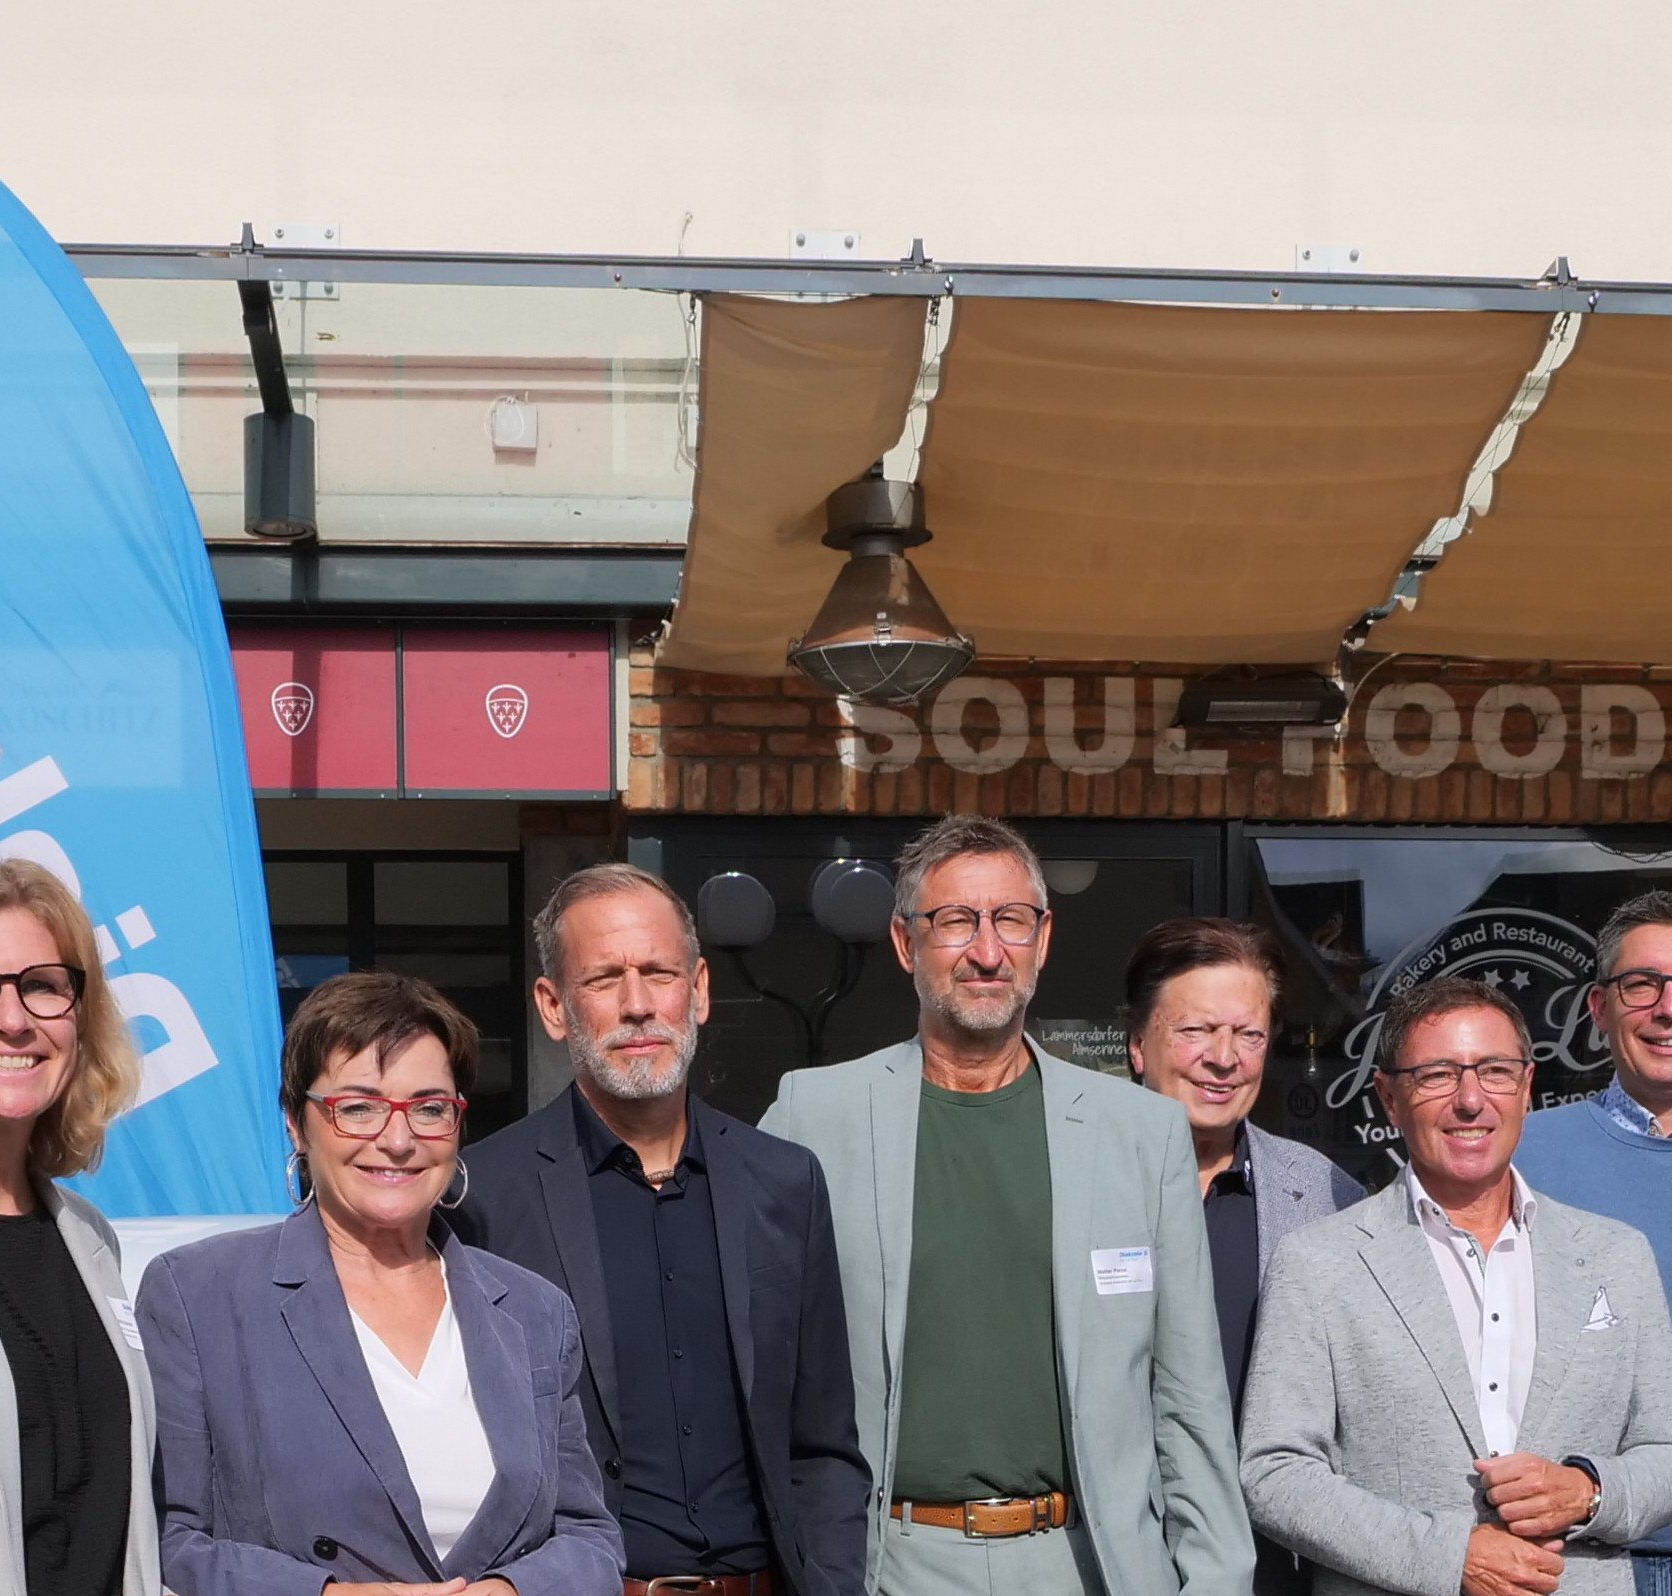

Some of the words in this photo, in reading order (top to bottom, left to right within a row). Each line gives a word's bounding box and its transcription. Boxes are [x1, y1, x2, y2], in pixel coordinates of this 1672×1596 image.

[835, 676, 1228, 776] SOUL
[1390, 944, 1448, 998] Bakery
[1449, 926, 1489, 952] and
[1493, 921, 1597, 974] Restaurant
[1042, 1026, 1126, 1042] Lammersdorfer
[1355, 1123, 1403, 1144] You
